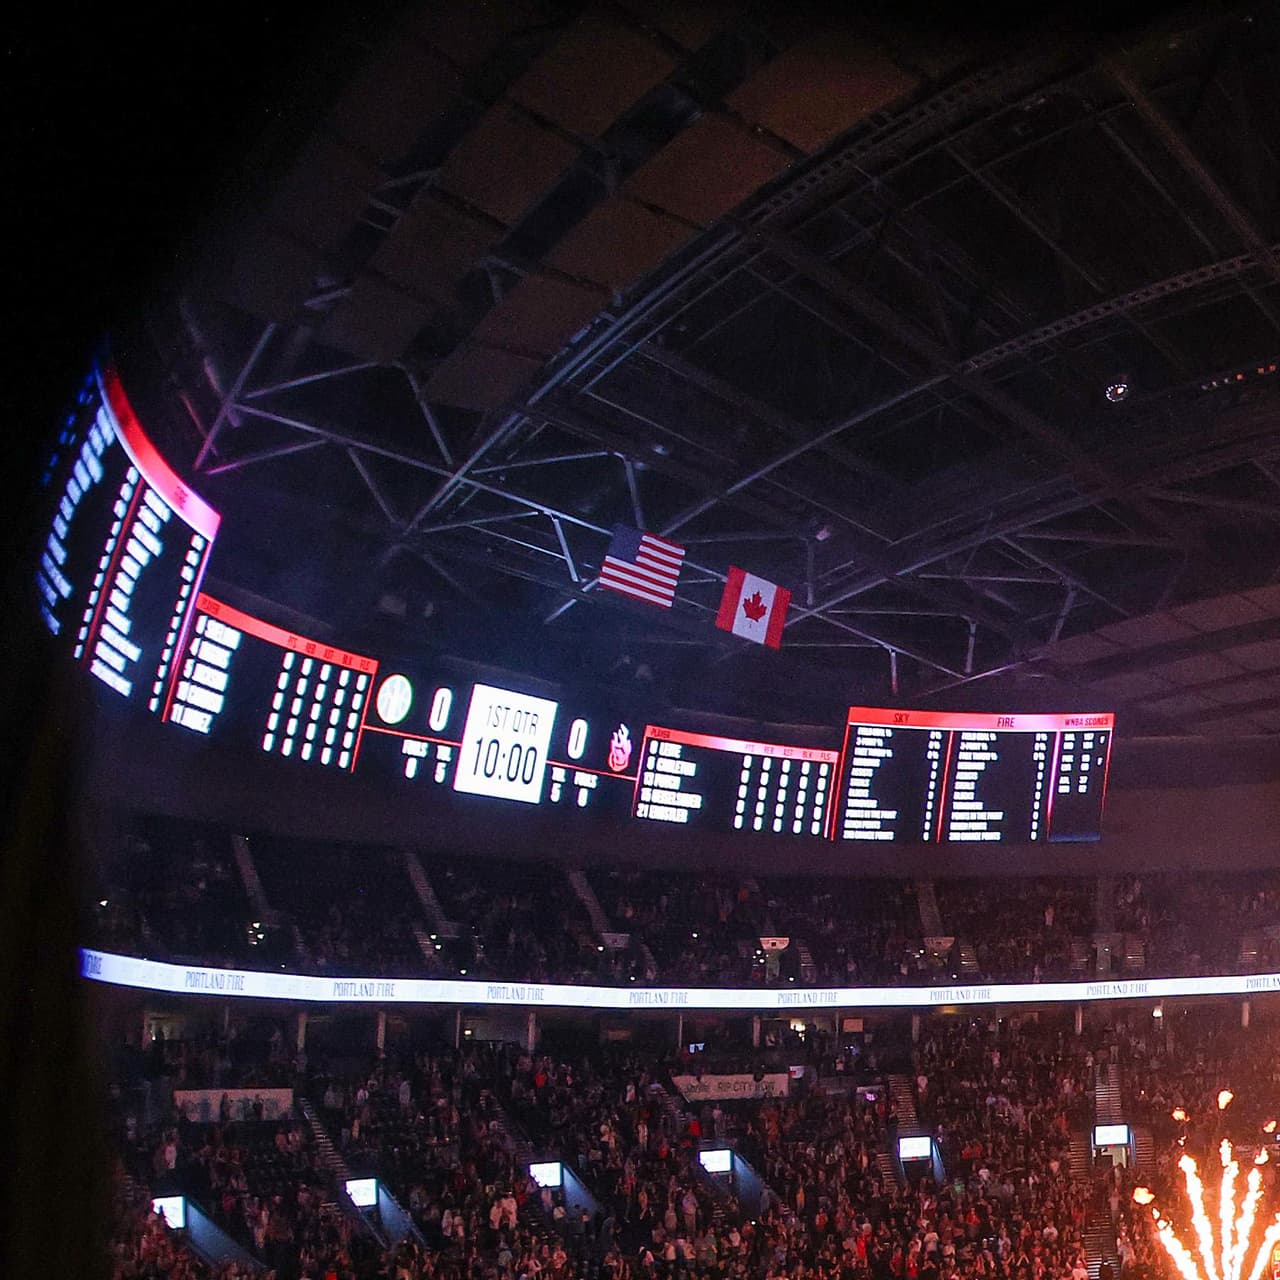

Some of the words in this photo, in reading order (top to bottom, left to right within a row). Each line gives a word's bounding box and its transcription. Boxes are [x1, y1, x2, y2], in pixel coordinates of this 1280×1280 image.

[429, 688, 453, 731] 0
[487, 705, 509, 729] 1ST
[514, 711, 539, 735] QTR
[893, 713, 910, 723] SKY
[997, 717, 1016, 728] FIRE
[567, 719, 588, 759] 0
[473, 737, 537, 785] 10:00
[184, 970, 225, 990] PORTLAND
[226, 975, 245, 991] FIRE
[332, 980, 373, 997] PORTLAND
[374, 982, 395, 998] FIRE
[487, 985, 525, 1000] PORTLAND
[526, 987, 544, 1001] FIRE
[929, 988, 969, 1001] PORTLAND
[970, 988, 990, 1001] FIRE
[1086, 983, 1126, 996] PORTLAND
[1127, 983, 1147, 996] FIRE
[629, 991, 668, 1004] PORTLAND
[669, 991, 688, 1004] FIRE
[777, 991, 816, 1004] PORTLAND
[818, 991, 837, 1004] FIRE
